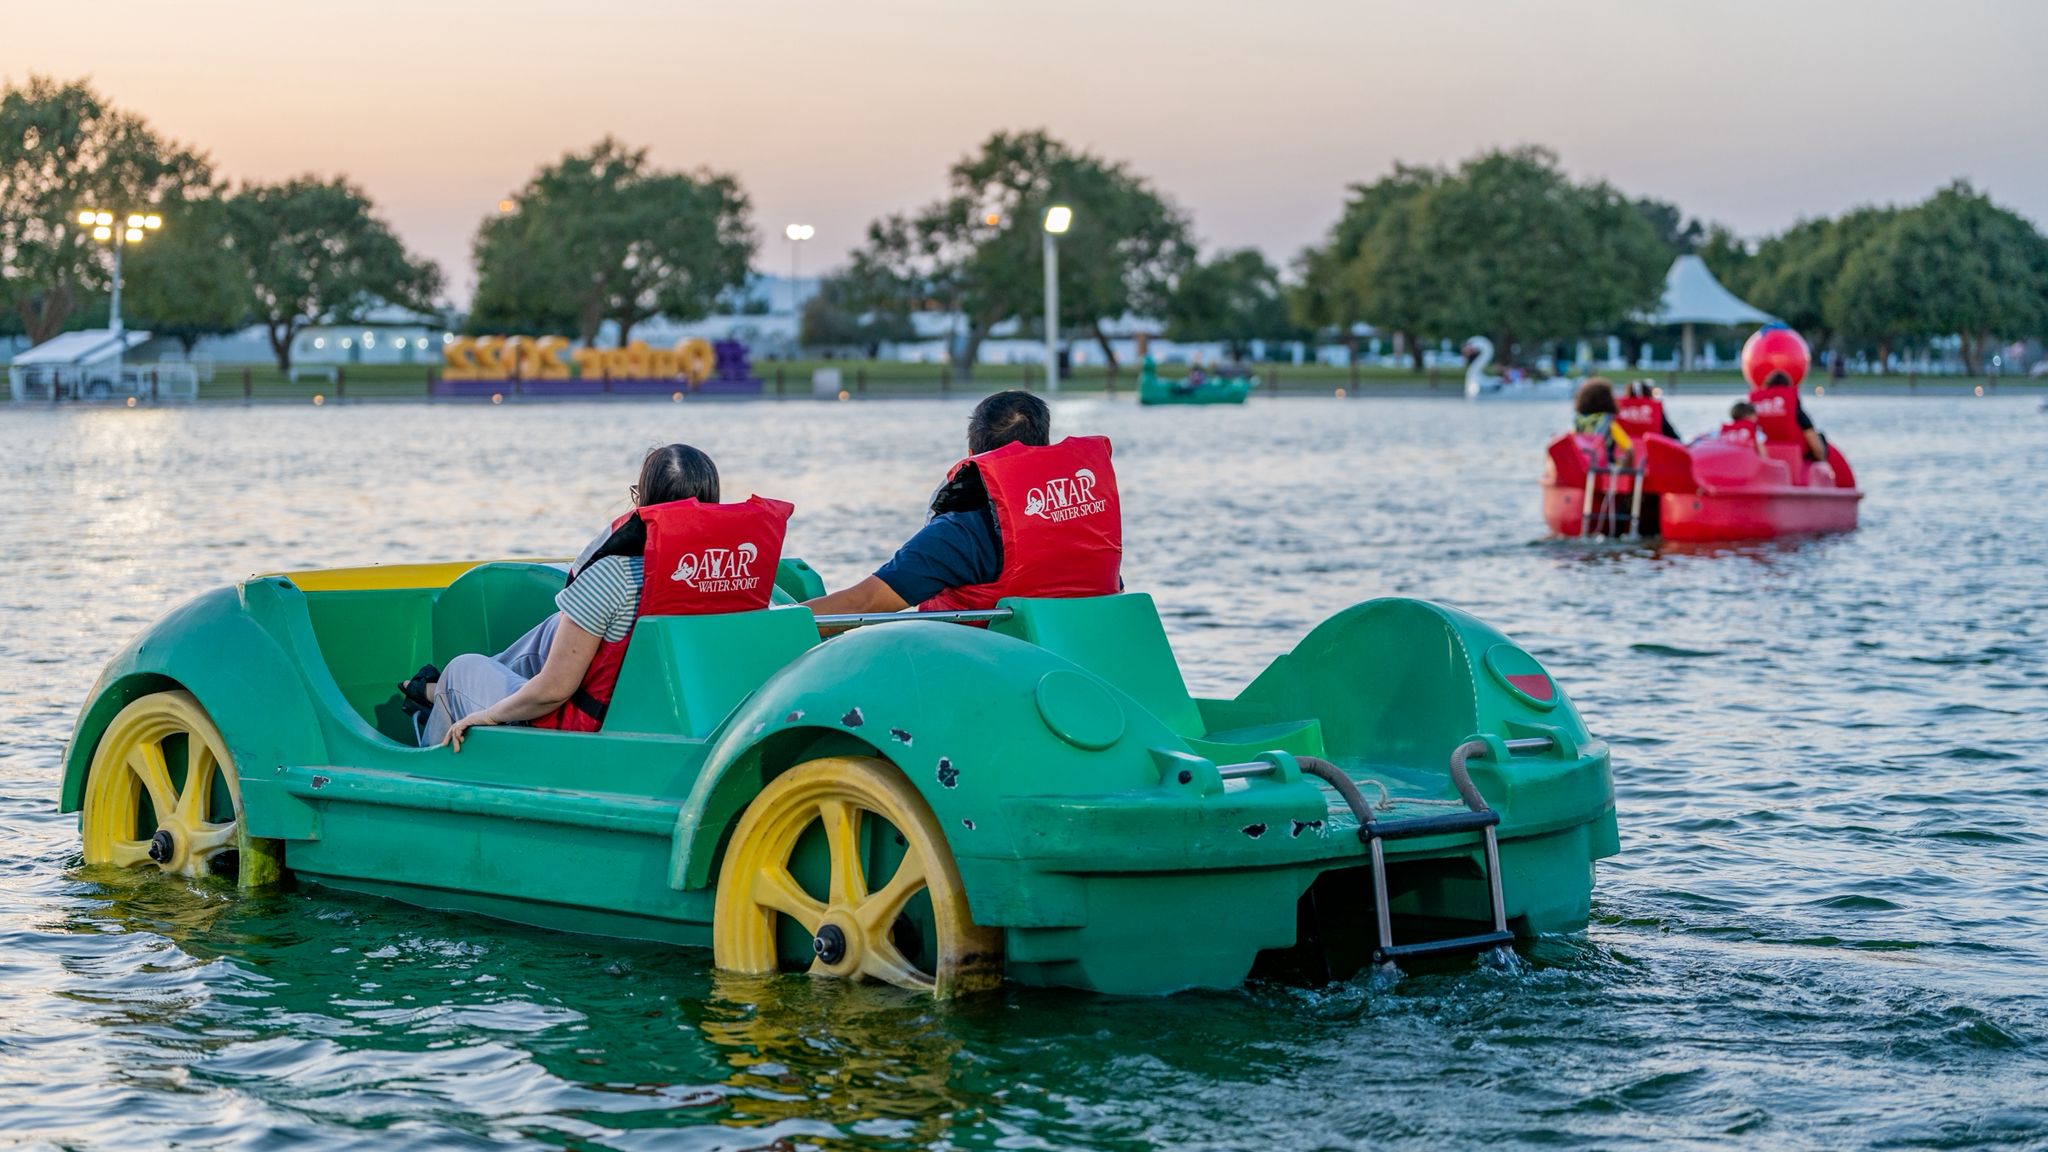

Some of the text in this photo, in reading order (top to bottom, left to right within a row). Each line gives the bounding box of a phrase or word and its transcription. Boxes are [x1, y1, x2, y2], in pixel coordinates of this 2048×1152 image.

[1024, 468, 1096, 520] QATAR
[1050, 499, 1106, 523] WATER SPORT
[671, 542, 758, 588] QATAR
[698, 577, 760, 593] WATER SPORT
